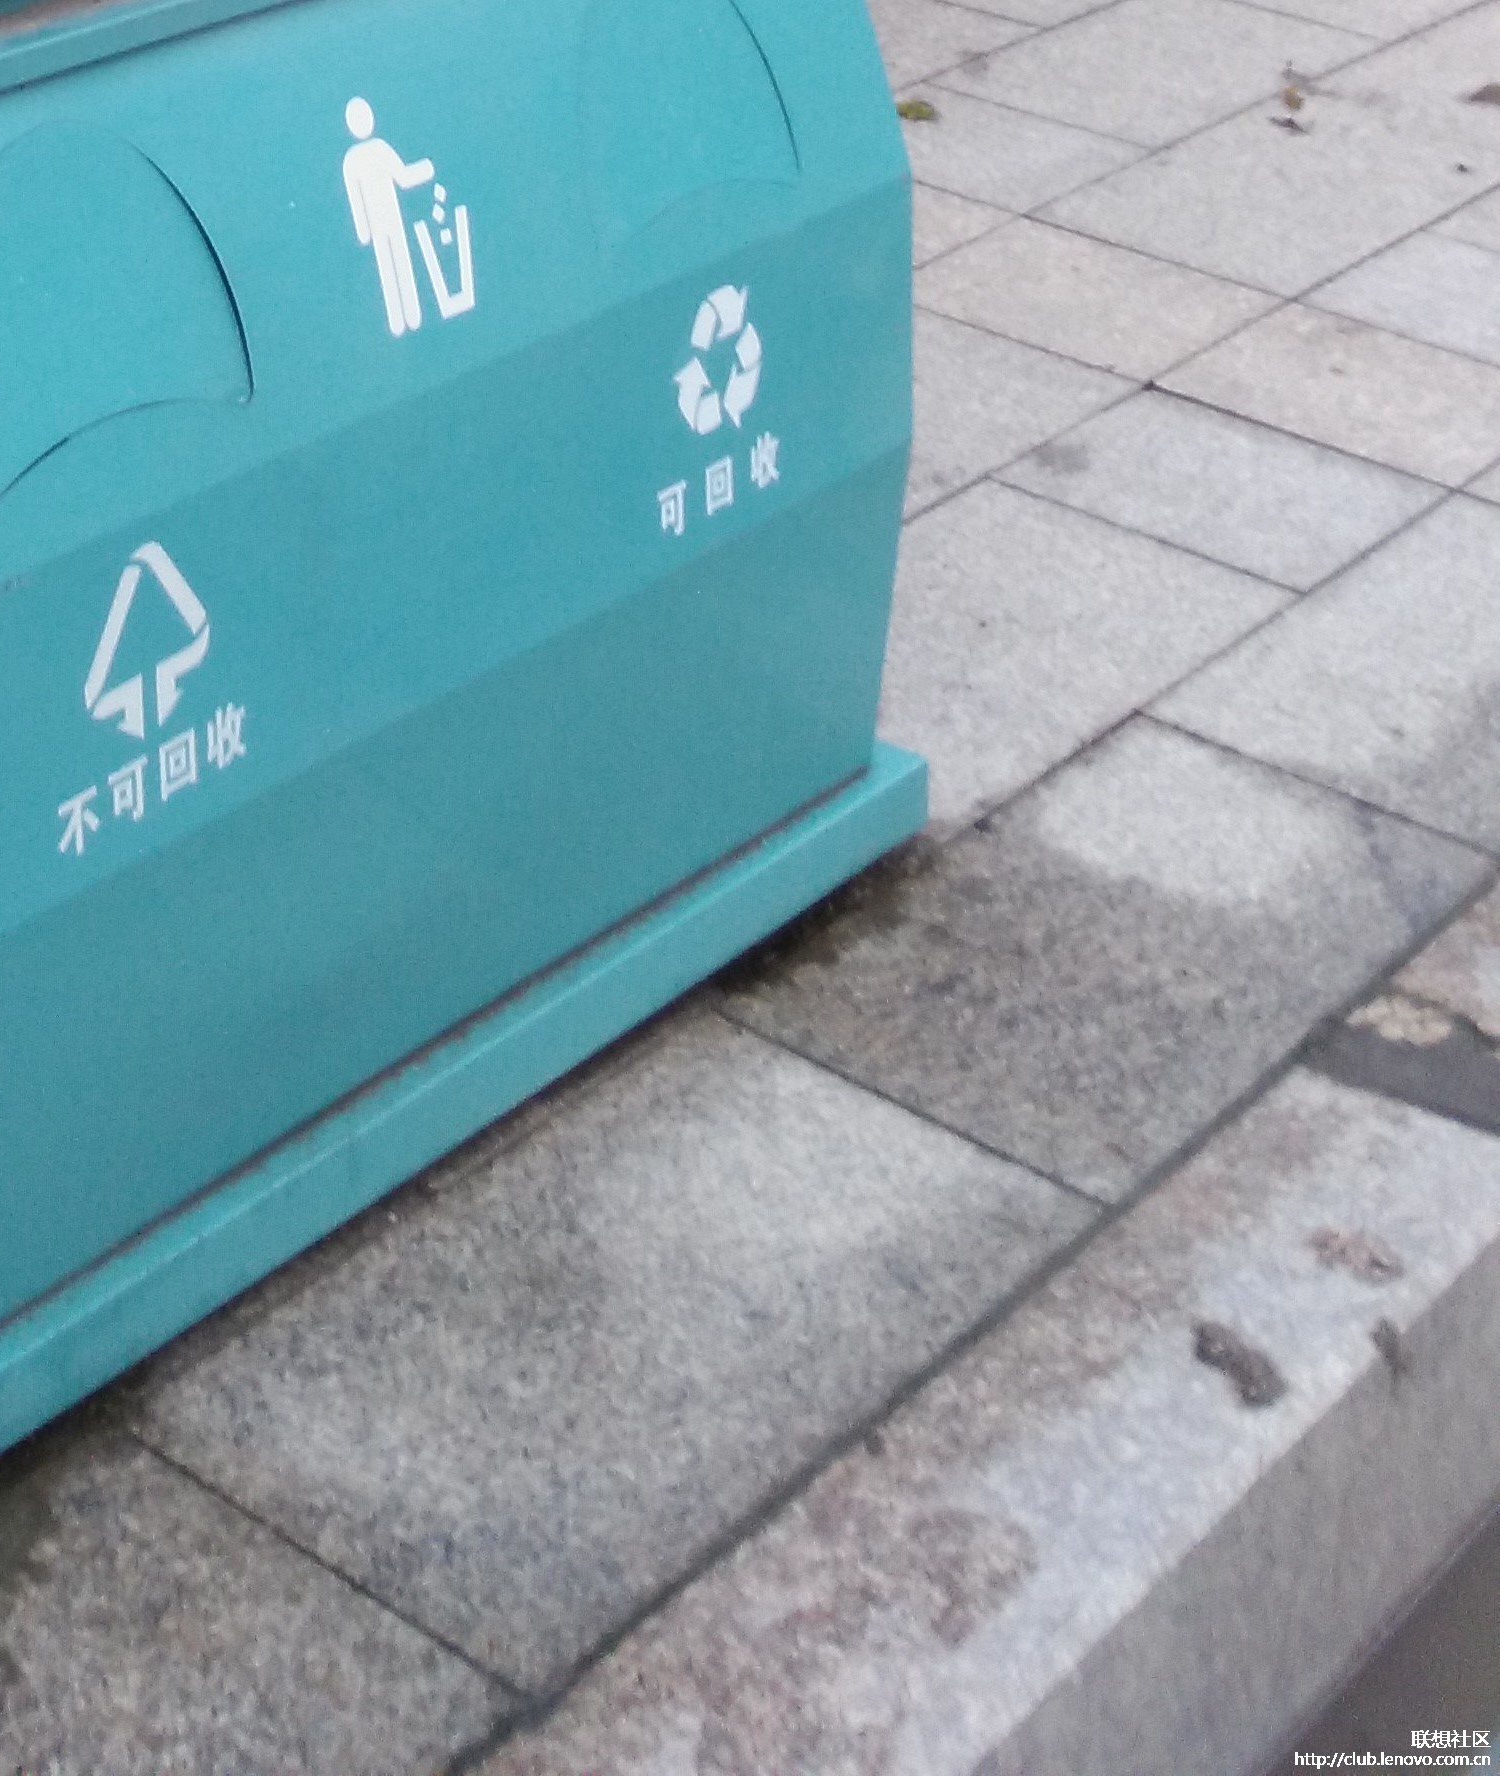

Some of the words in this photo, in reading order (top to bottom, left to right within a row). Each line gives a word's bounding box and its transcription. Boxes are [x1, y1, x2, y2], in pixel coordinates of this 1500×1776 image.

[657, 432, 780, 535] 可回收
[58, 703, 247, 855] 不可回收
